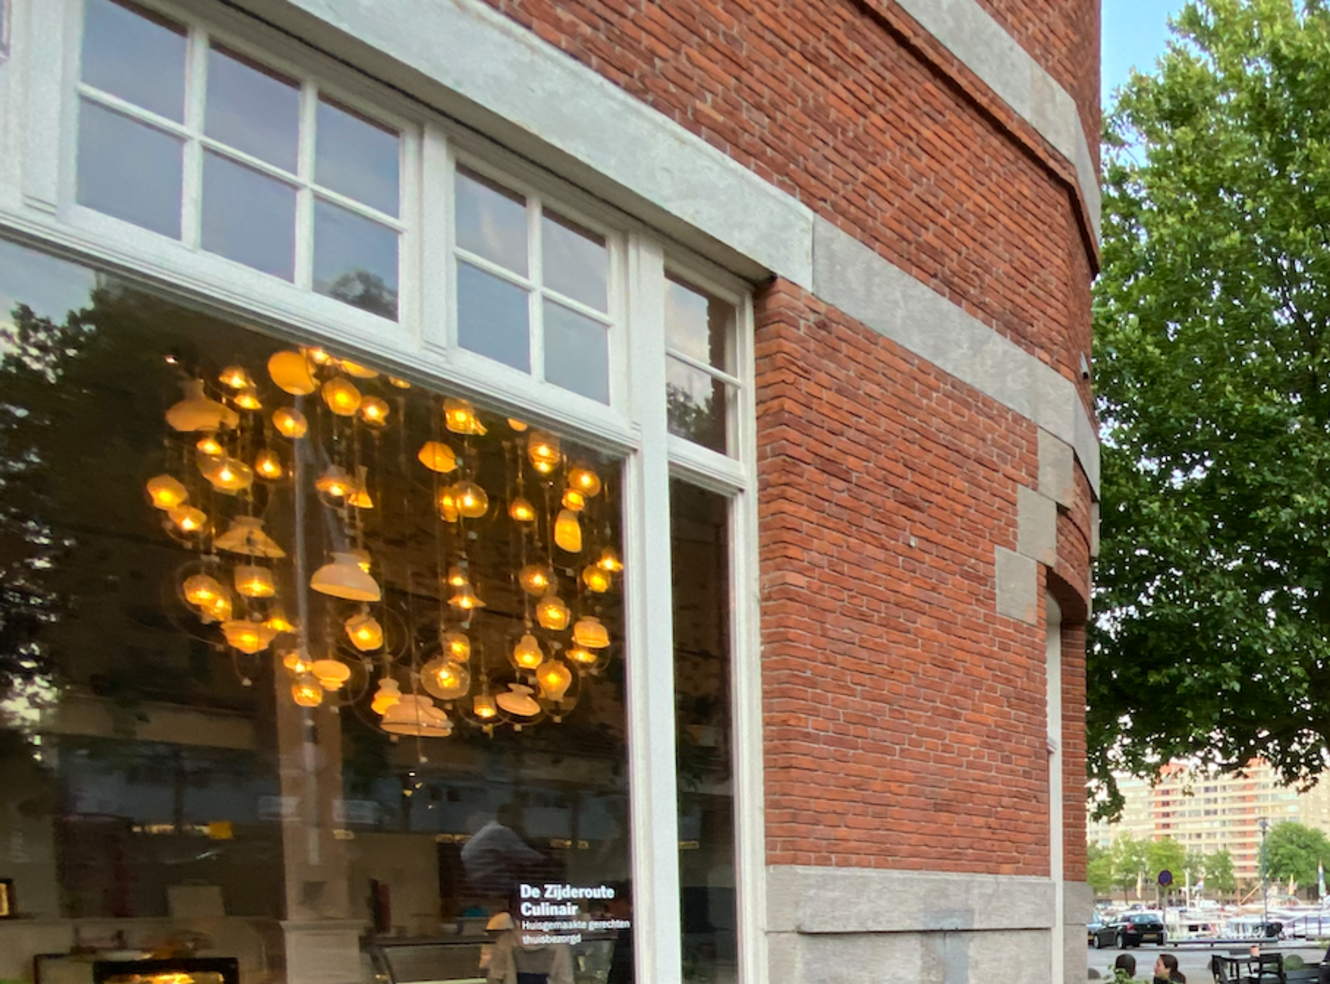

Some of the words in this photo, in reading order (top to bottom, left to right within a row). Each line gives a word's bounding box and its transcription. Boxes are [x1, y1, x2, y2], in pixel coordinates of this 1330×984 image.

[520, 884, 540, 898] De
[544, 884, 615, 900] Zijderoute
[520, 902, 579, 916] Culinair
[522, 920, 587, 931] Huisgemaakte
[589, 920, 630, 930] gerechten
[522, 934, 582, 945] thuisbezorgd
